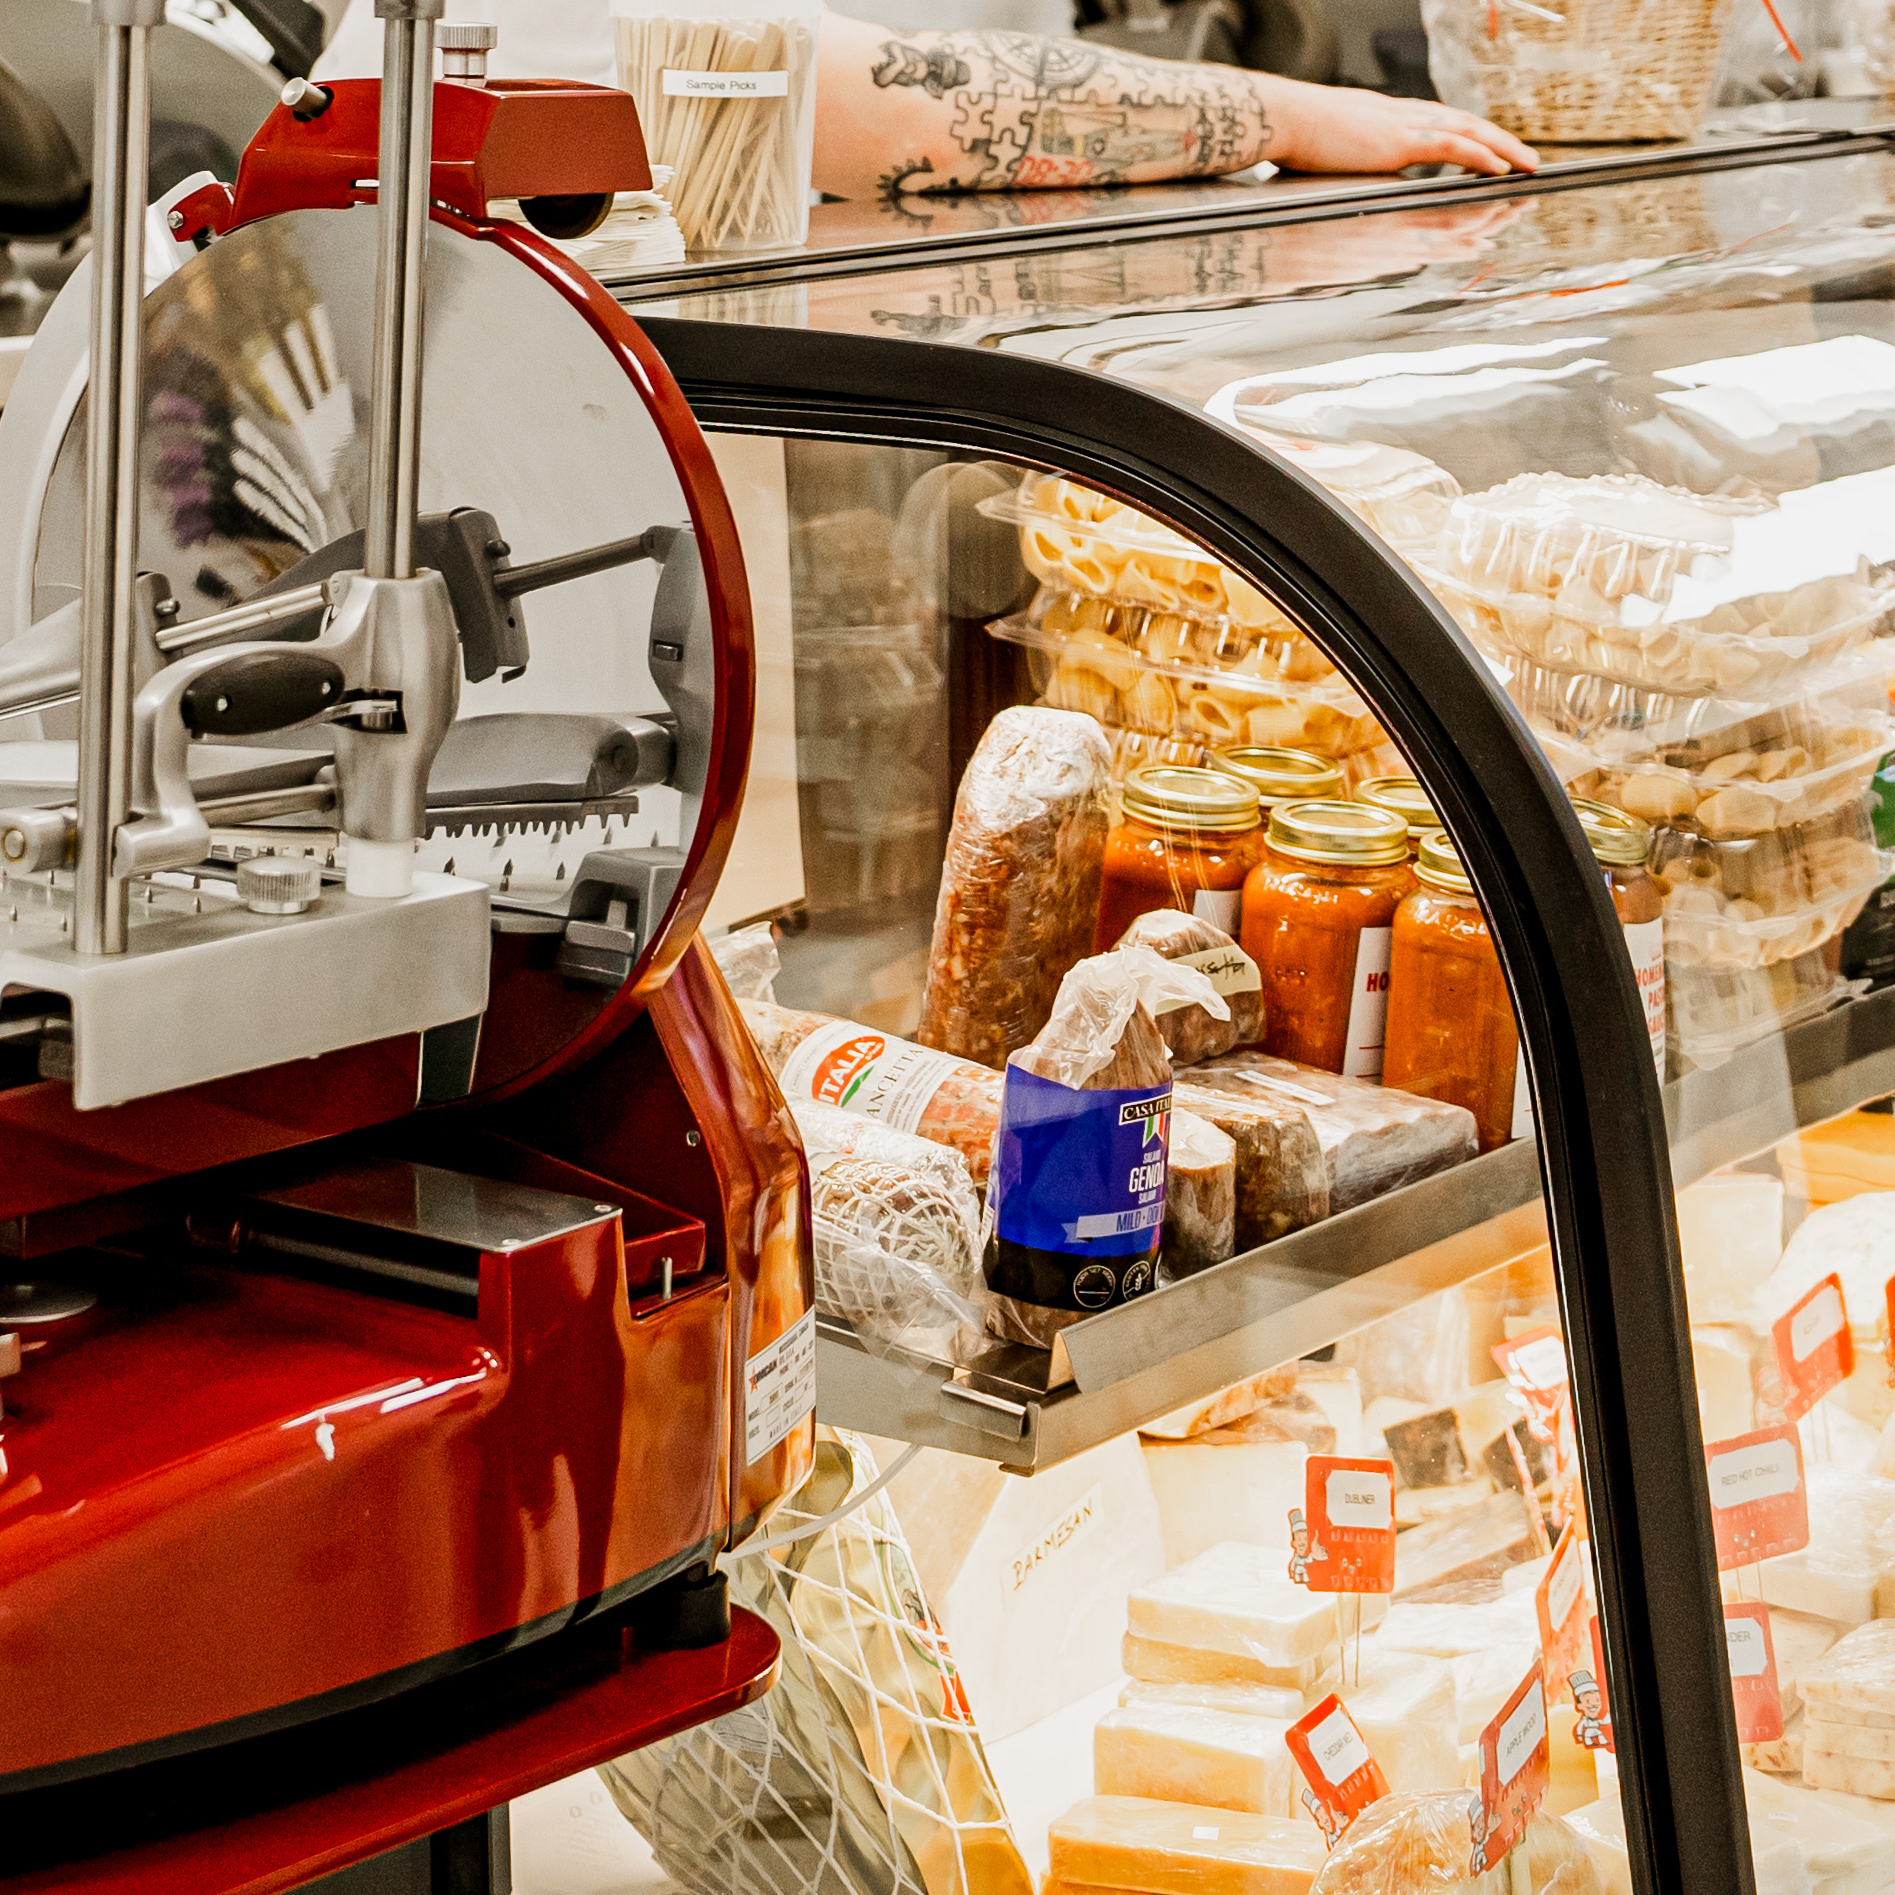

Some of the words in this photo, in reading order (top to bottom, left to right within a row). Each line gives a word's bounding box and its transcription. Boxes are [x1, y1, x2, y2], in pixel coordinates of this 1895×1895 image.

[686, 79, 726, 91] Sample
[729, 79, 758, 90] Picks
[1365, 971, 1389, 993] HO
[819, 1041, 876, 1103] ITALIA
[865, 1048, 924, 1119] ANCETTA
[1123, 1104, 1155, 1120] CASA
[1115, 1210, 1141, 1232] MILD
[1721, 1472, 1738, 1486] RED
[1738, 1468, 1753, 1480] HOT
[1344, 1493, 1376, 1505] DUBLINER
[1012, 1496, 1093, 1592] PARMESAN
